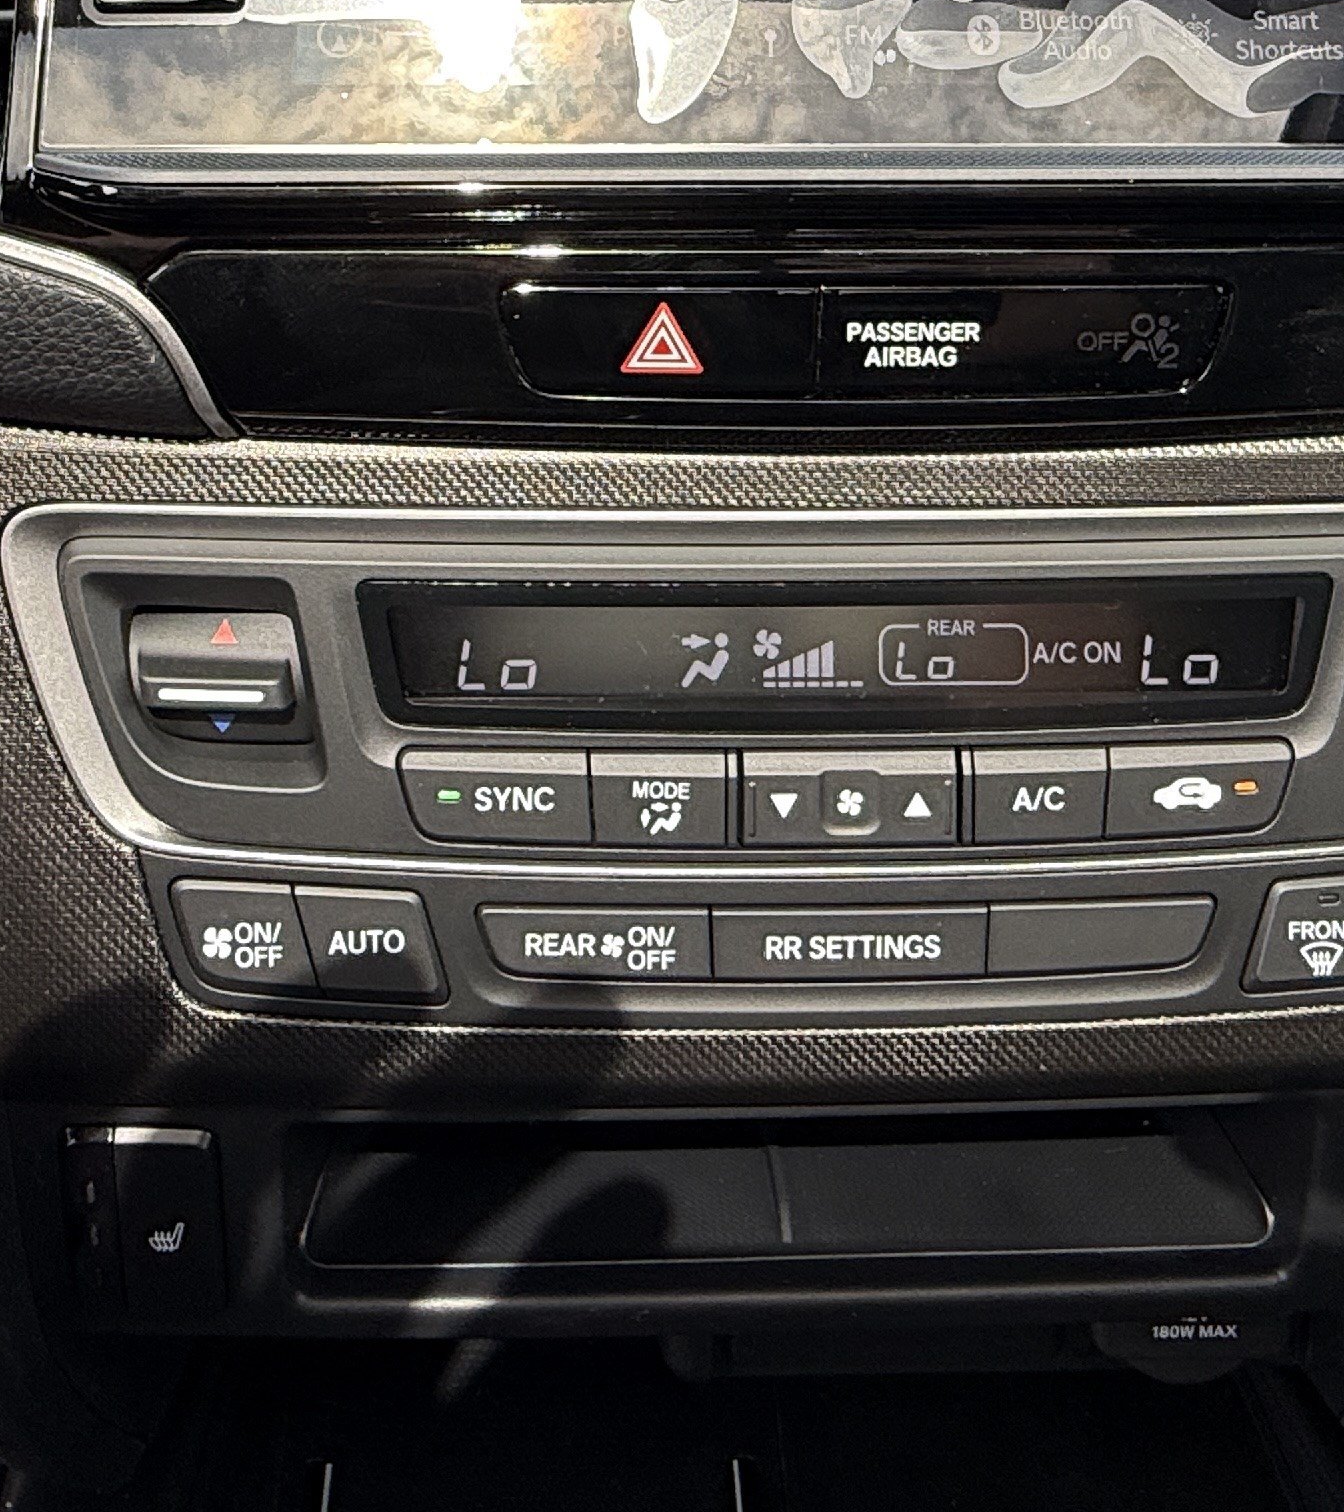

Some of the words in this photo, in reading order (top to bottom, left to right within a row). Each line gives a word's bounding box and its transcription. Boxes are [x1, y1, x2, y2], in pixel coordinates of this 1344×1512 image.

[1019, 9, 1132, 32] Bluetooth
[1254, 10, 1320, 31] Smart
[1044, 38, 1112, 61] Audio
[1236, 36, 1344, 63] Shortcuts
[846, 321, 981, 343] PASSENGER
[1076, 330, 1129, 352] OFF
[863, 345, 958, 368] AIRBAG
[927, 618, 976, 636] REAR
[1032, 640, 1078, 668] A/C
[1083, 640, 1122, 664] ON
[474, 786, 555, 812] SYNC
[632, 780, 691, 801] MODE
[1012, 785, 1066, 812] A/C
[233, 921, 282, 946] ON/
[328, 928, 406, 956] AUTO
[524, 932, 596, 957] REAR
[626, 926, 676, 950] ON/
[234, 946, 284, 969] OFF
[765, 935, 803, 961] RR
[808, 934, 942, 960] SETTINGS
[627, 949, 677, 971] OFF
[1152, 1325, 1195, 1339] 180W
[1198, 1324, 1238, 1338] MAX
